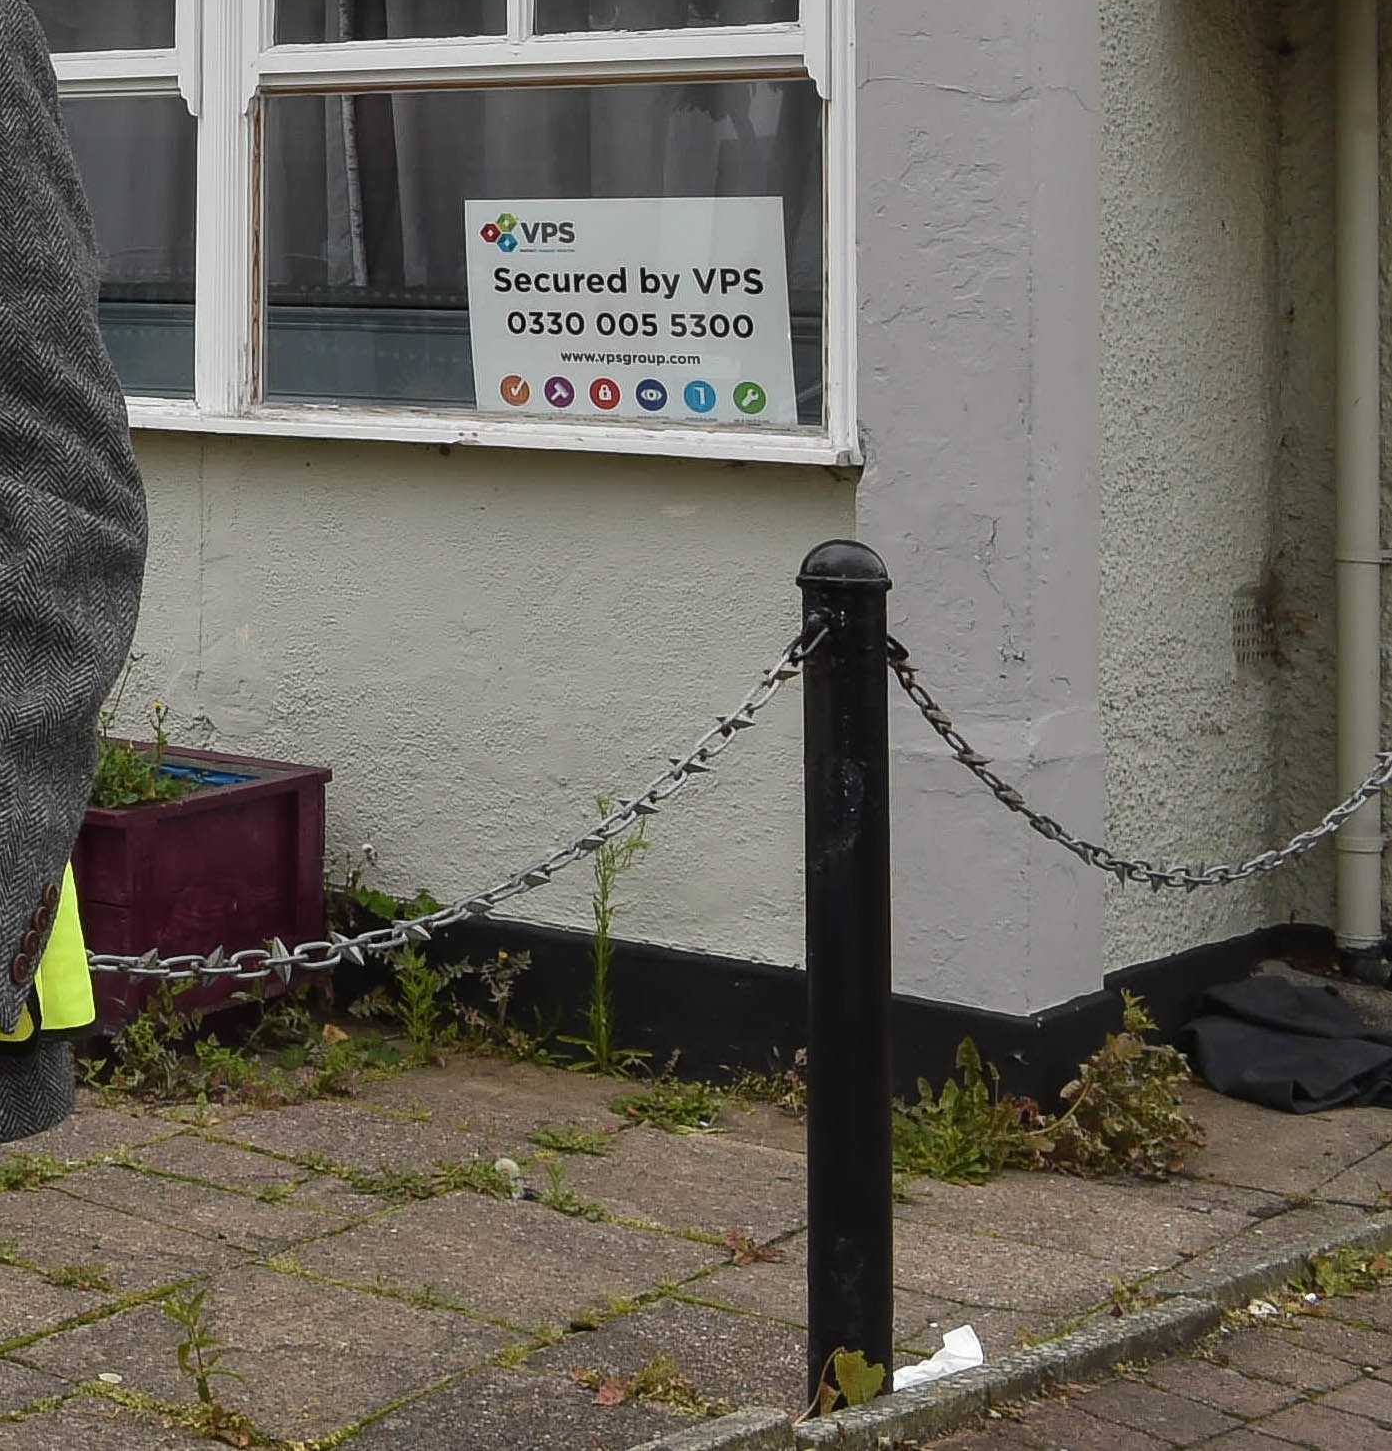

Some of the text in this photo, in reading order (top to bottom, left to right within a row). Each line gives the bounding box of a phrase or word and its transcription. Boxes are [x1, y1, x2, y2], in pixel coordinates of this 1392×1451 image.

[519, 221, 576, 244] VPS
[493, 266, 764, 300] Secured by VPS
[506, 311, 755, 339] 0330 005 5300
[560, 351, 702, 365] www.vpsgroup.com
